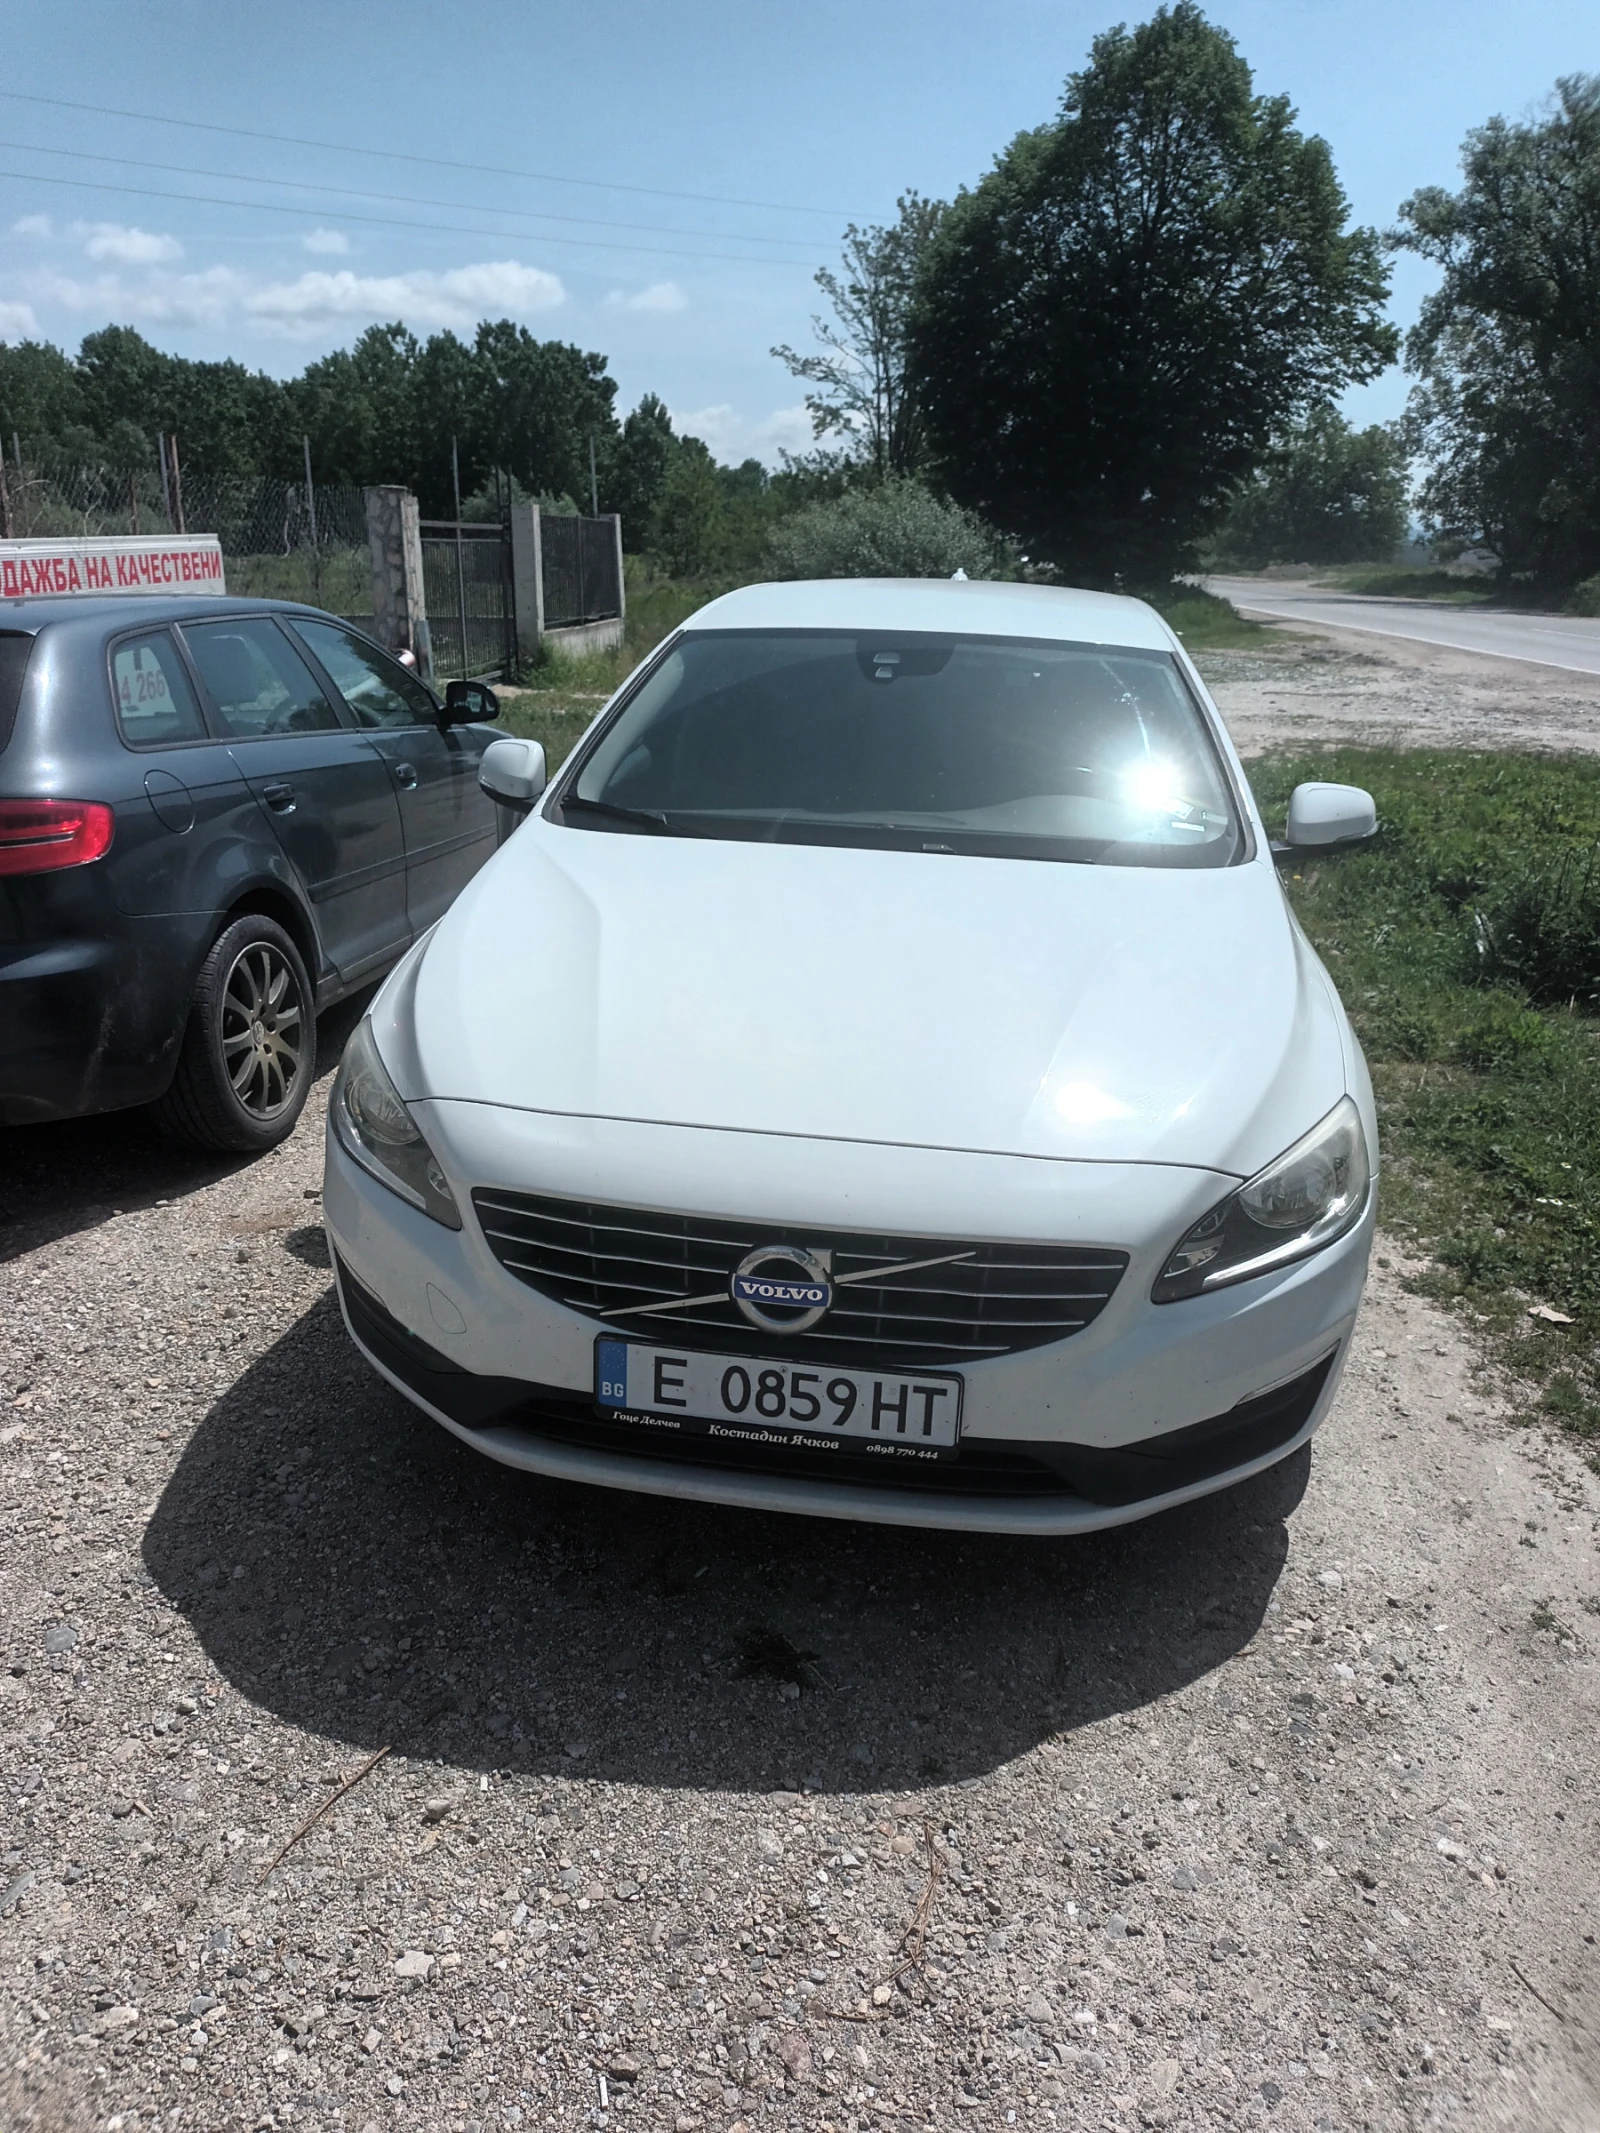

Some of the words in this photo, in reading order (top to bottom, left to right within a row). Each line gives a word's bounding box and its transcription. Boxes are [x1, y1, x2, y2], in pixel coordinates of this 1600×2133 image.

[0, 557, 82, 597] ДАЖБА
[85, 556, 113, 588] НА
[116, 551, 222, 586] КАЧЕСТВЕНИ
[739, 1281, 823, 1301] VOLVO
[602, 1381, 624, 1398] BG
[612, 1411, 639, 1423] Гоце
[640, 1415, 681, 1429] Делчев
[708, 1424, 788, 1445] Костадин
[789, 1434, 840, 1450] Ячков
[866, 1444, 895, 1455] 0898
[896, 1448, 916, 1457] 770
[917, 1450, 939, 1460] 444
